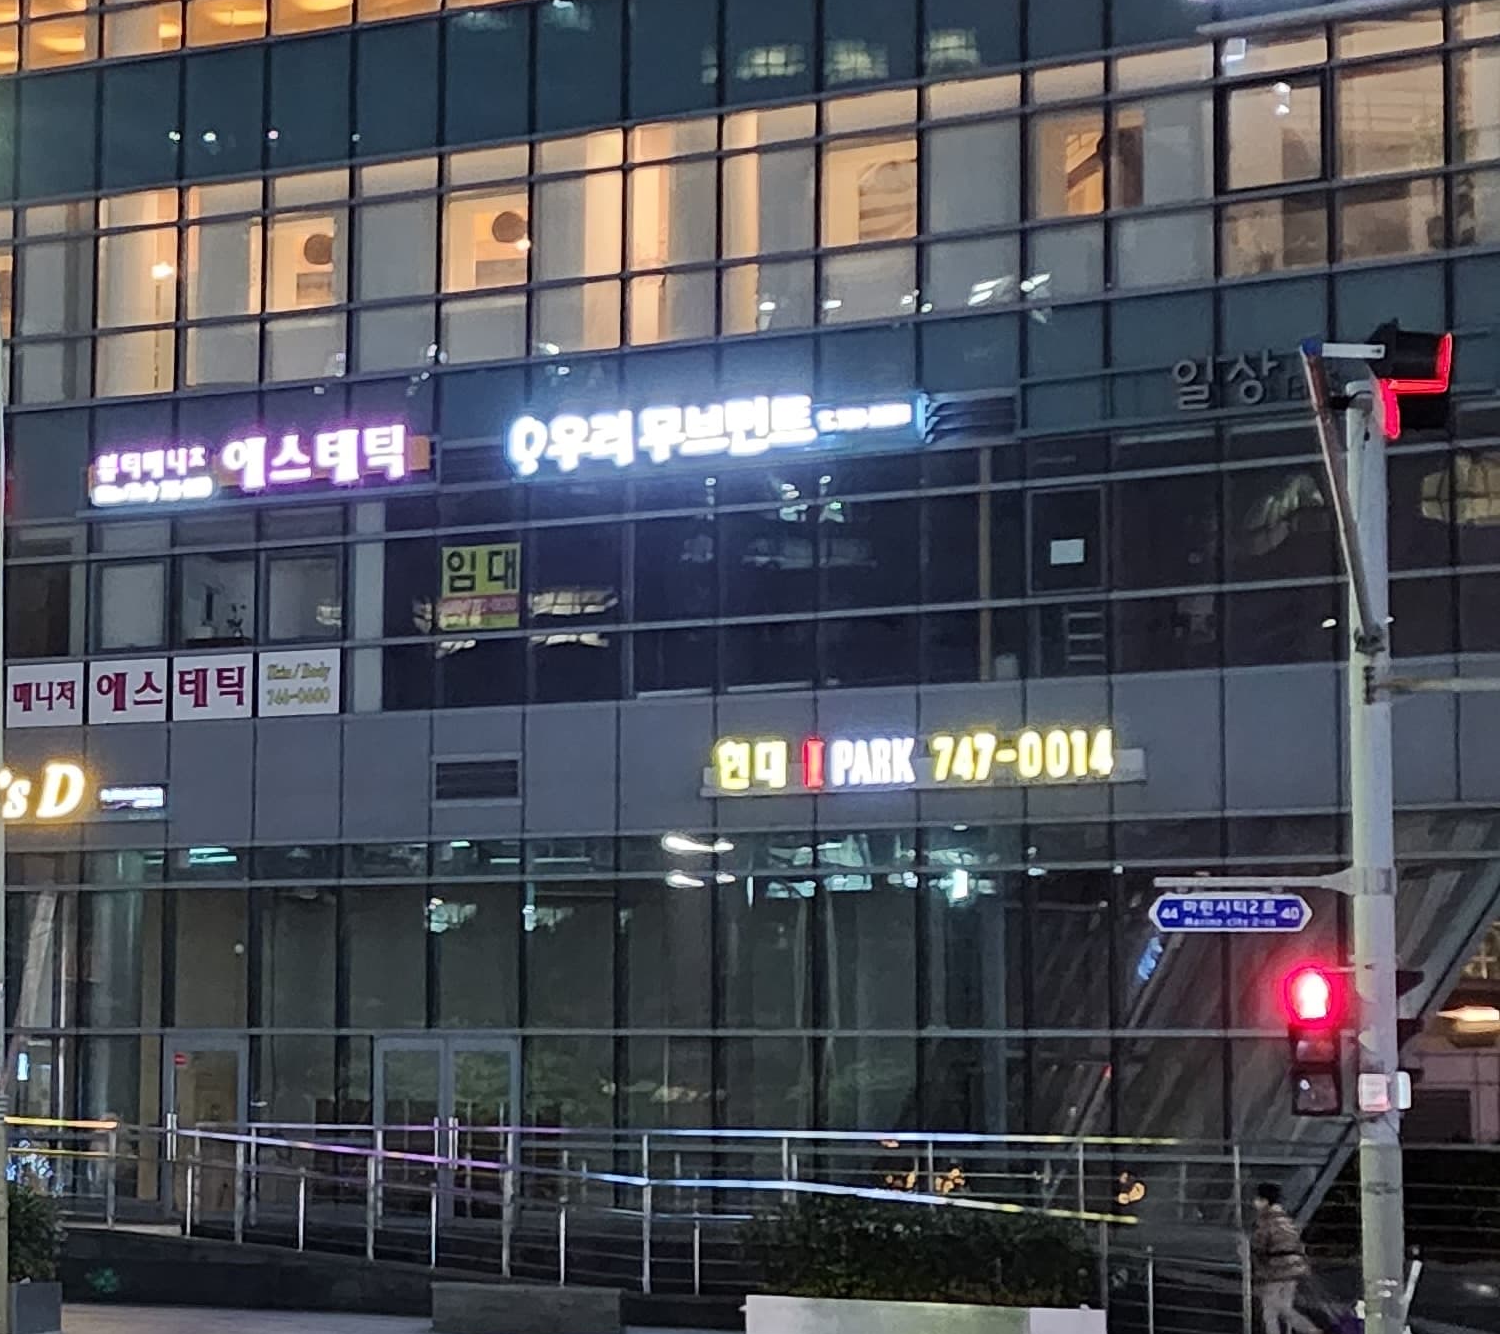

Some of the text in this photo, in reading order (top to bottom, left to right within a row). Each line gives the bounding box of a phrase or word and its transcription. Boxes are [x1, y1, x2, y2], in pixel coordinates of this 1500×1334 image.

[1171, 349, 1281, 411] 일상
[223, 424, 405, 489] 에스테틱
[446, 548, 517, 593] 임대
[96, 666, 246, 712] 에스테틱
[830, 736, 917, 787] PARK
[932, 727, 1115, 783] 747-0014
[37, 762, 85, 820] D
